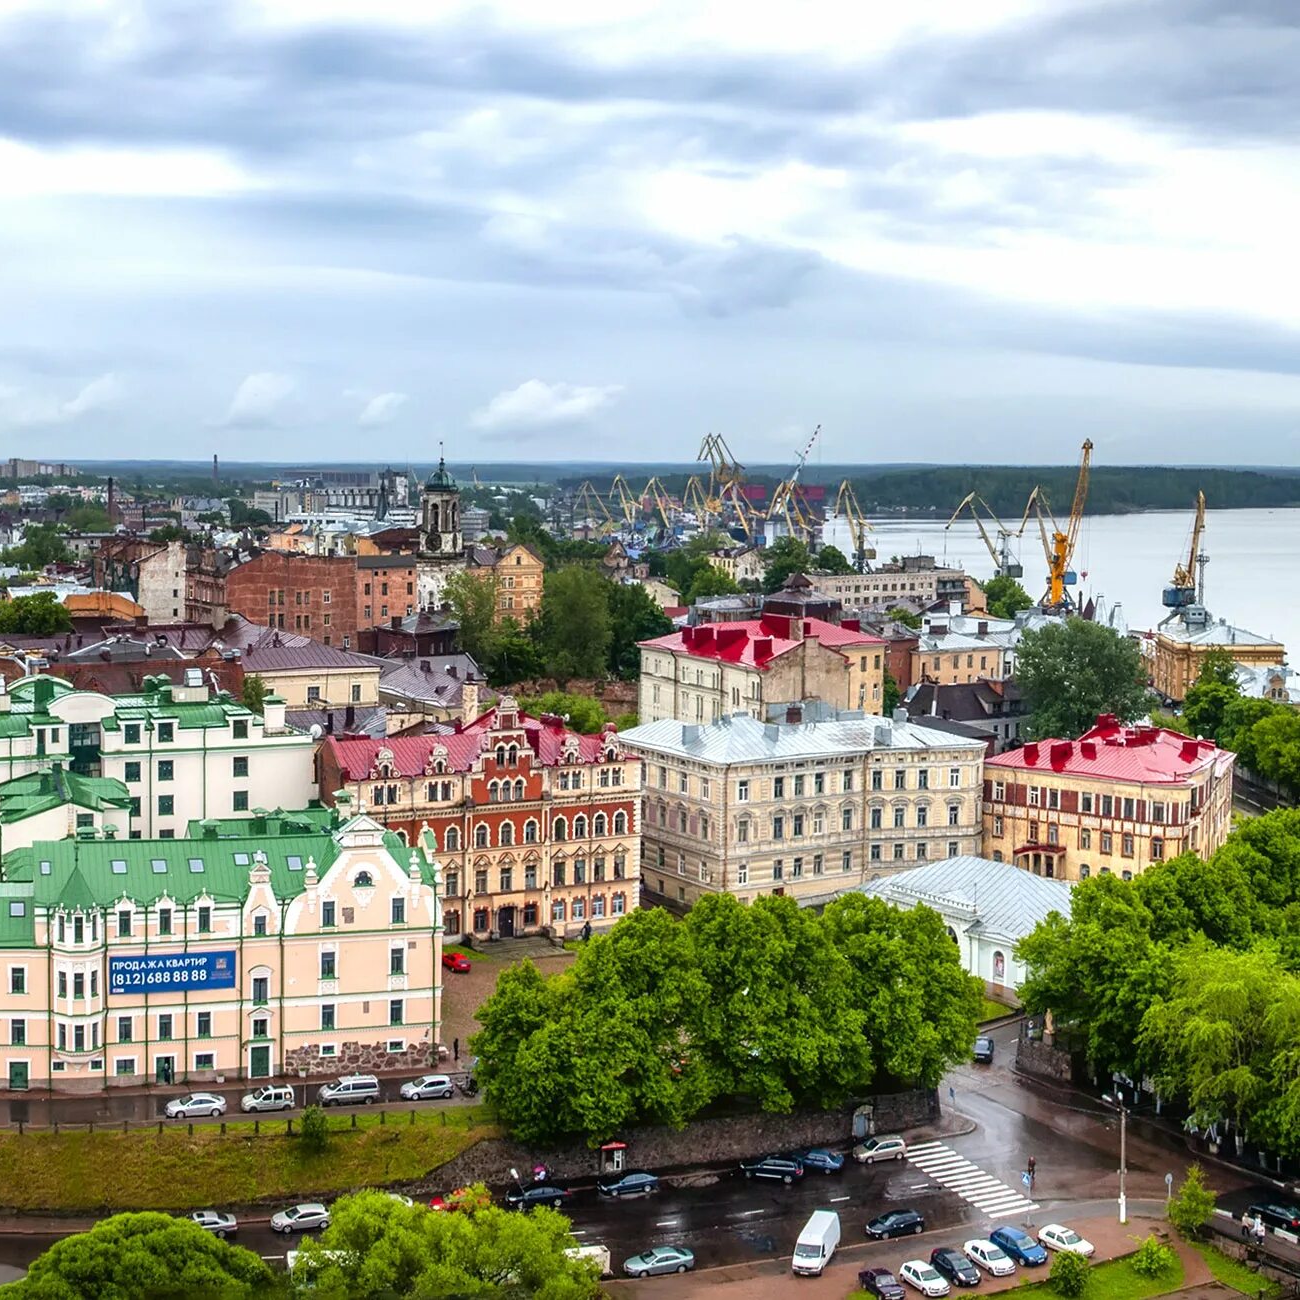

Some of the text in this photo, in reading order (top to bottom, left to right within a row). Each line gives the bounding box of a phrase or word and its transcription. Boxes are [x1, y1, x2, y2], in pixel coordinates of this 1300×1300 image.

[112, 957, 207, 971] ПРОДАЖА КВАРТИР
[112, 973, 145, 986] (812)
[146, 971, 171, 984] 688
[172, 970, 189, 983] 88
[191, 969, 207, 982] 88
